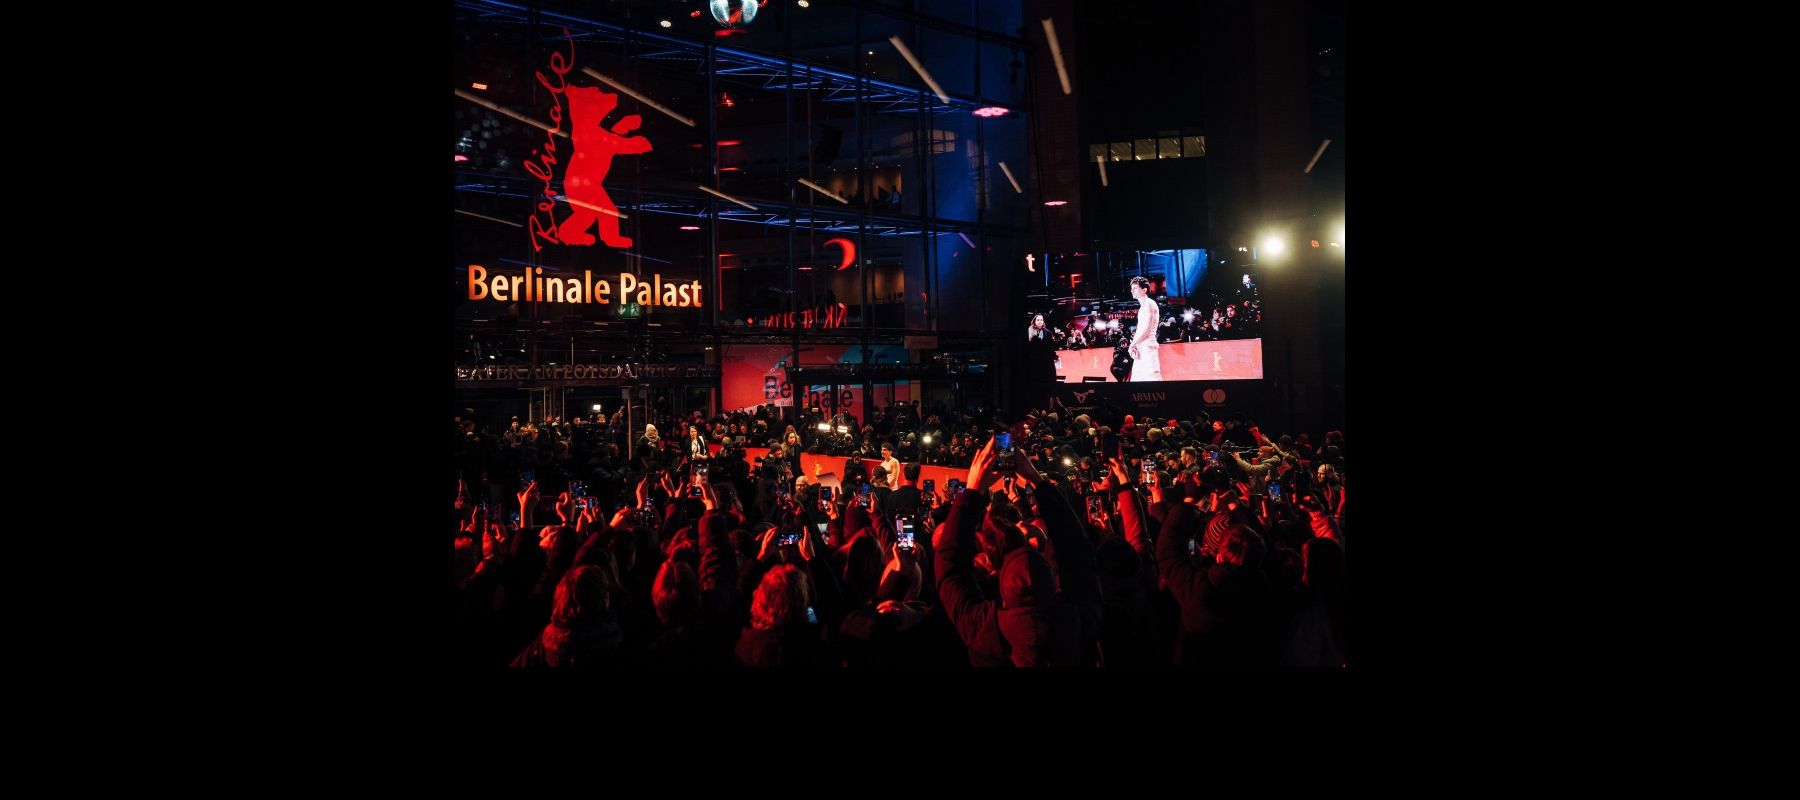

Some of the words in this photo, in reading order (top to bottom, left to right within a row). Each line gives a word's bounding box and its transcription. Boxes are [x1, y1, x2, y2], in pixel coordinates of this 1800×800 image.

[523, 26, 576, 253] Berlinale
[468, 264, 611, 306] Berlinale
[620, 272, 703, 309] Palast
[1131, 391, 1166, 401] ARMANI
